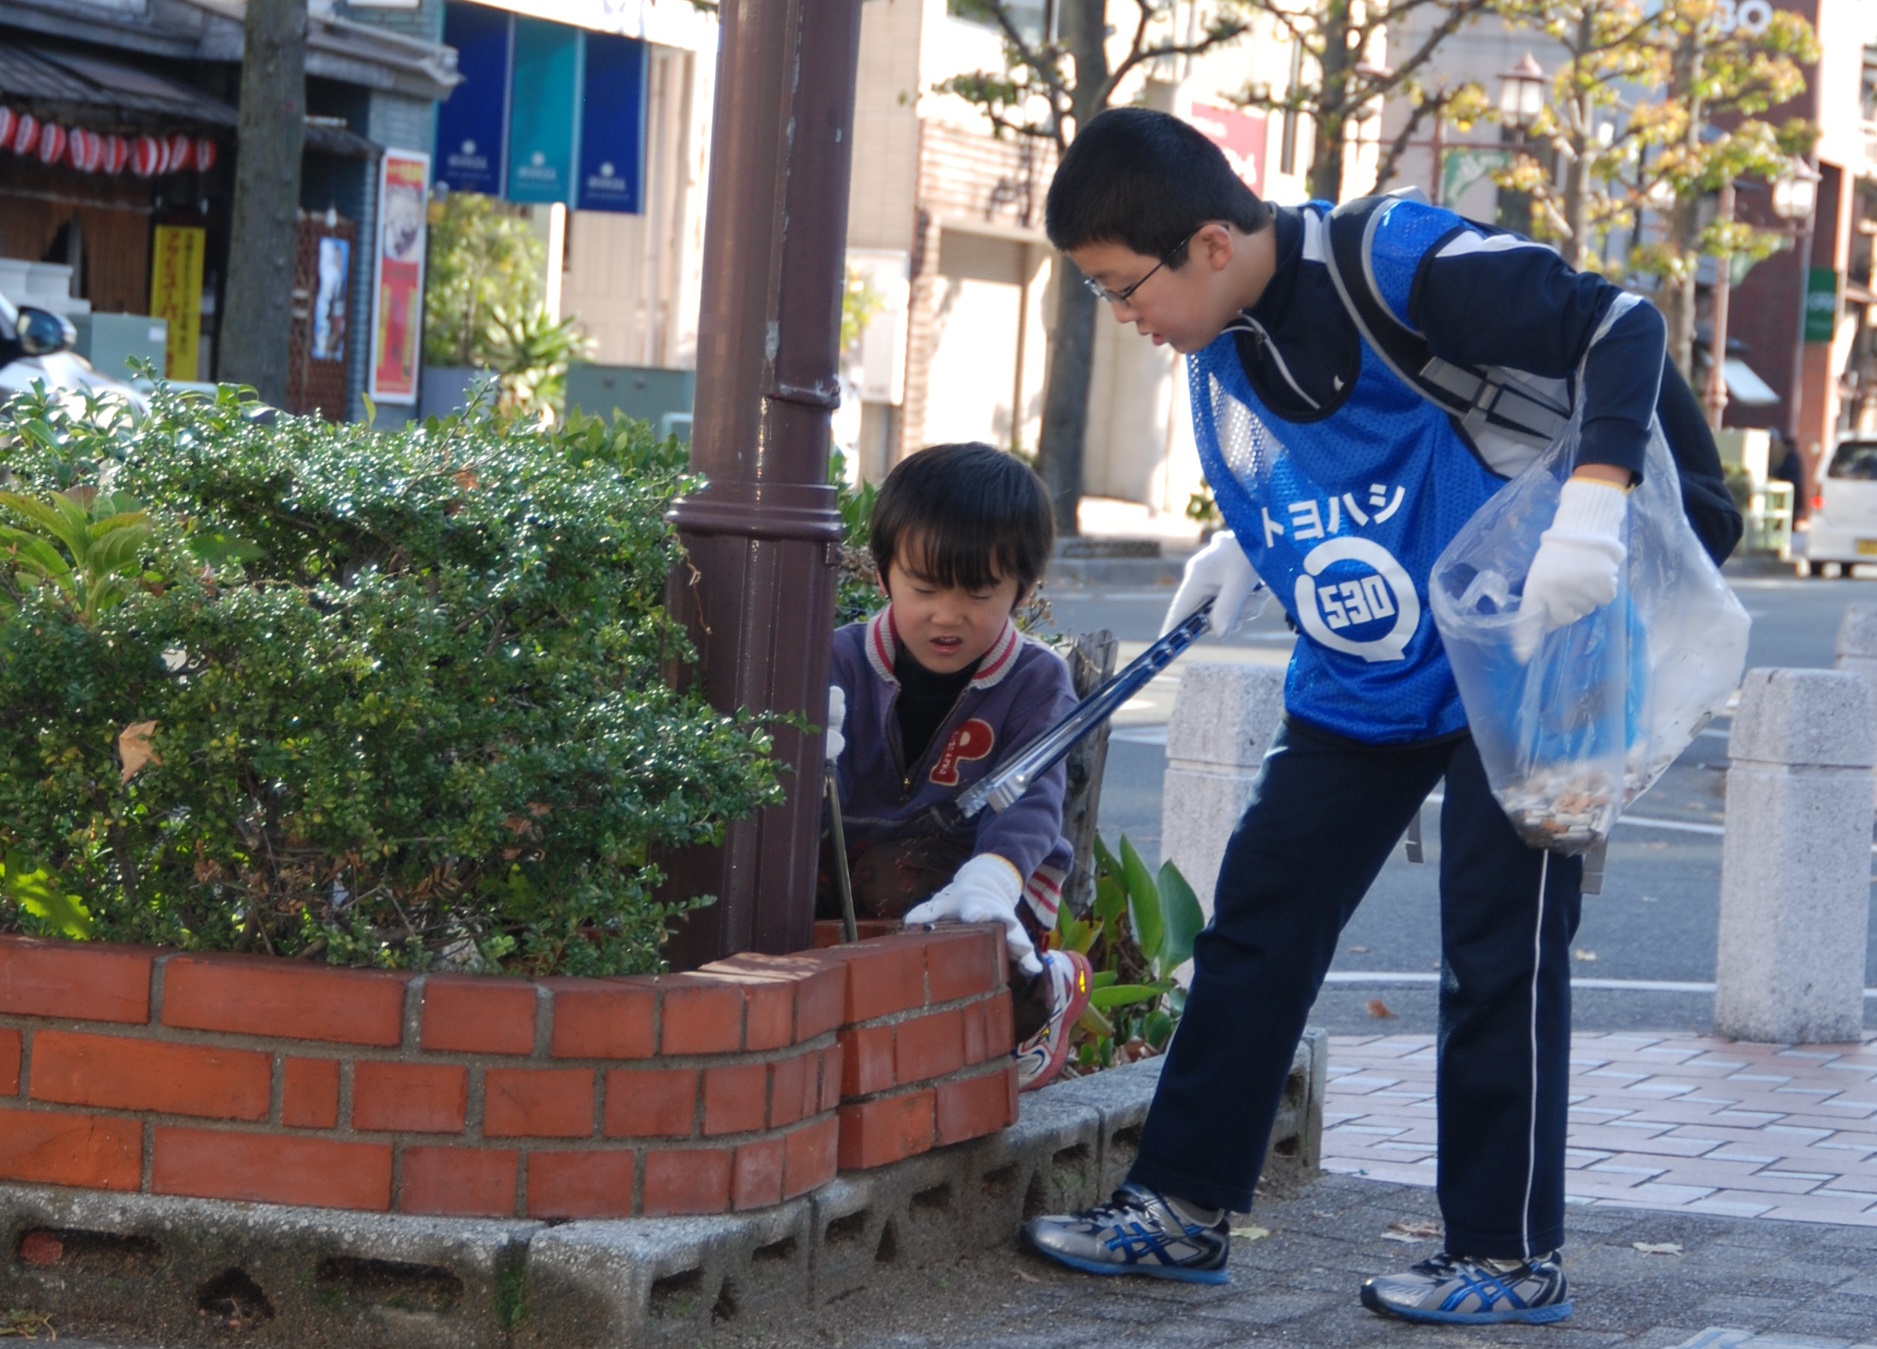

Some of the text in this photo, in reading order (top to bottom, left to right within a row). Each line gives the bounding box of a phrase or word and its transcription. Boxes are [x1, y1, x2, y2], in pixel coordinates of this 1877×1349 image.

[1261, 483, 1406, 549] トヨハシ
[1317, 574, 1396, 630] 530
